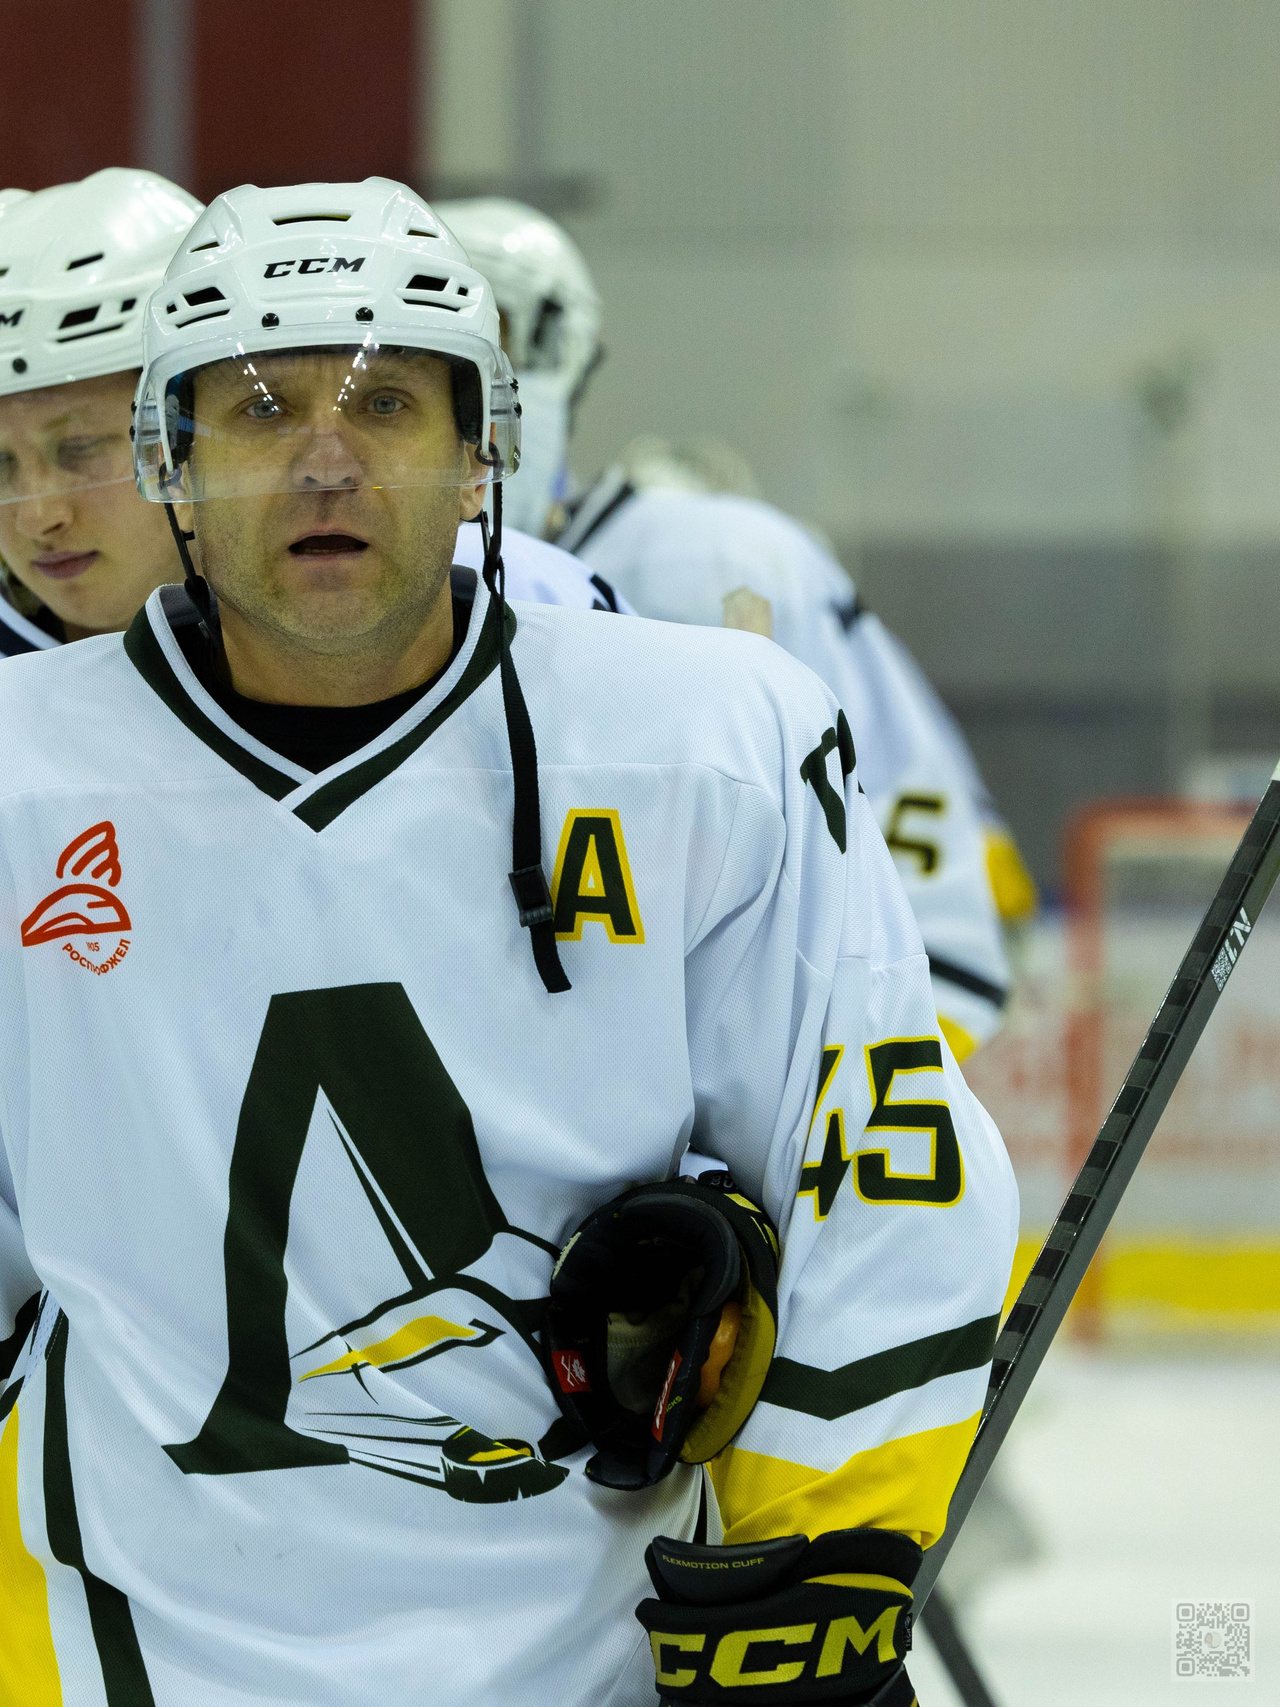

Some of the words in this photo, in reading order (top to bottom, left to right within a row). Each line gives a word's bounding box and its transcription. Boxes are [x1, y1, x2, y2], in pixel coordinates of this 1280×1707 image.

[264, 257, 366, 279] CCM
[549, 808, 645, 944] A
[797, 1036, 966, 1222] 45
[662, 1554, 729, 1570] FLEXMOTION
[732, 1557, 765, 1569] CUFF
[650, 1605, 903, 1688] CCM
